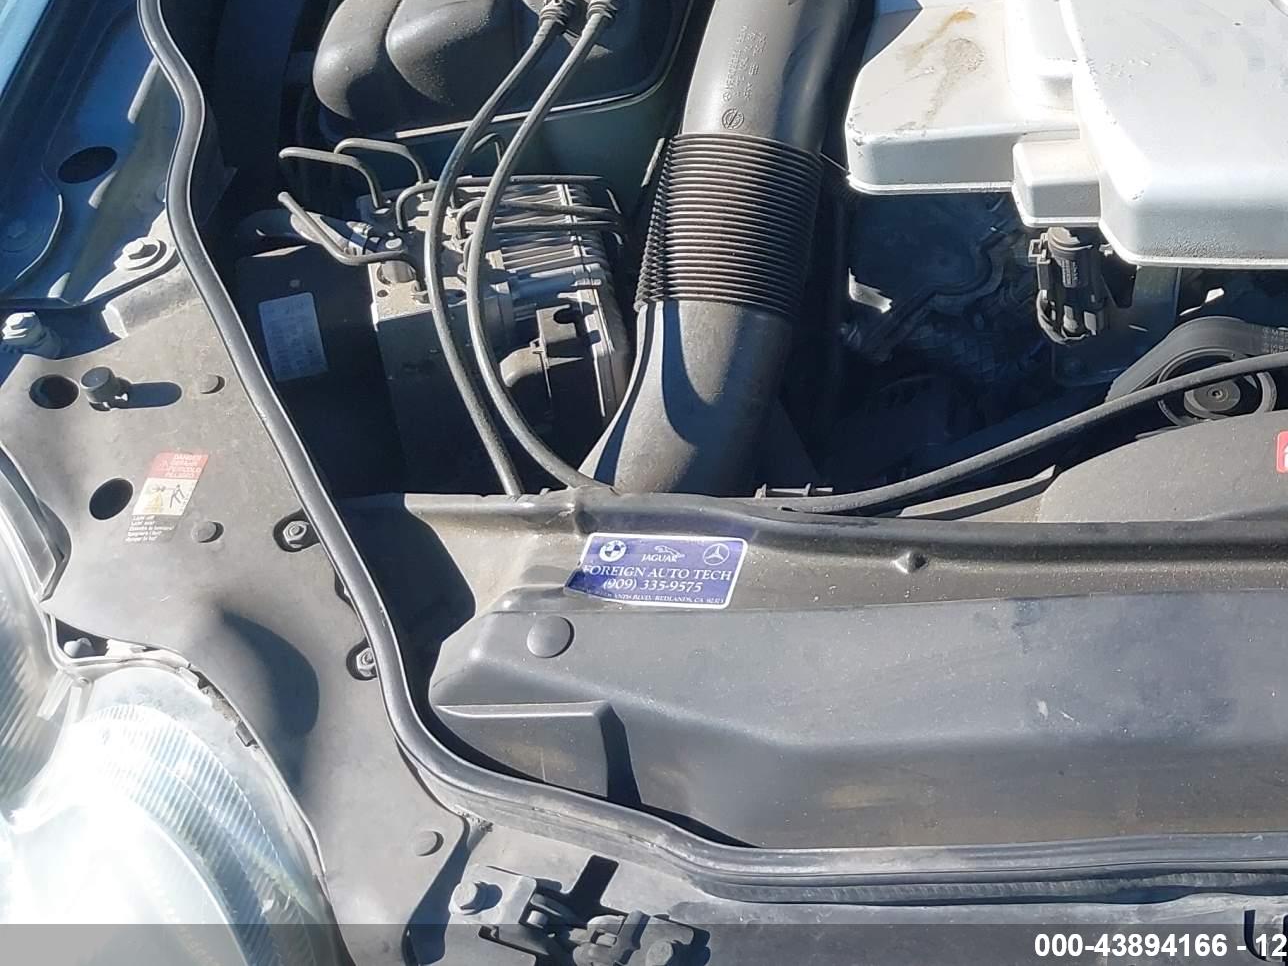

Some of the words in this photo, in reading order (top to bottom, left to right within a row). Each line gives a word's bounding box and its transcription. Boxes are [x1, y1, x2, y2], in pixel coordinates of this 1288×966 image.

[641, 554, 678, 562] JAGUAR
[583, 565, 646, 577] FOREIGN
[648, 568, 690, 578] AUTO
[694, 569, 732, 581] TECH
[603, 578, 637, 590] (909)
[640, 580, 703, 593] 335-9575
